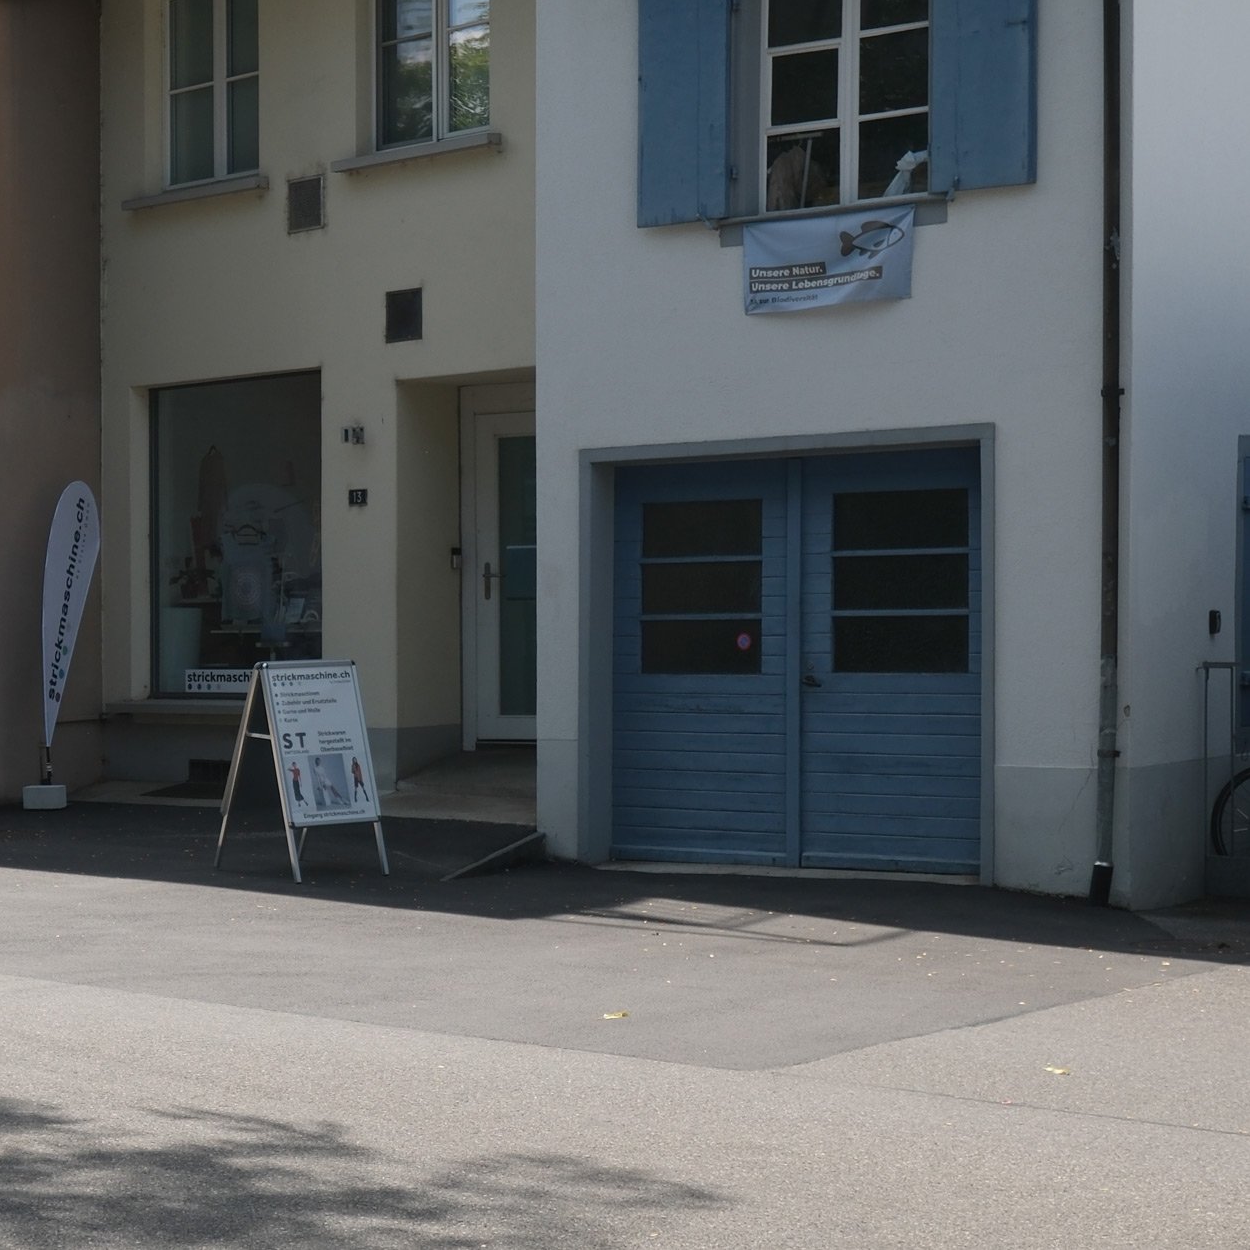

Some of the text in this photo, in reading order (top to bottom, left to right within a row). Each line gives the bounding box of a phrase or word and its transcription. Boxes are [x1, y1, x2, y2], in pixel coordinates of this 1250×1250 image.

[751, 265, 823, 278] Unsere Natur.
[751, 281, 789, 292] Unsere
[353, 491, 362, 503] 13
[48, 496, 85, 701] strickmaschine.ch
[271, 670, 351, 682] strickmaschine.ch
